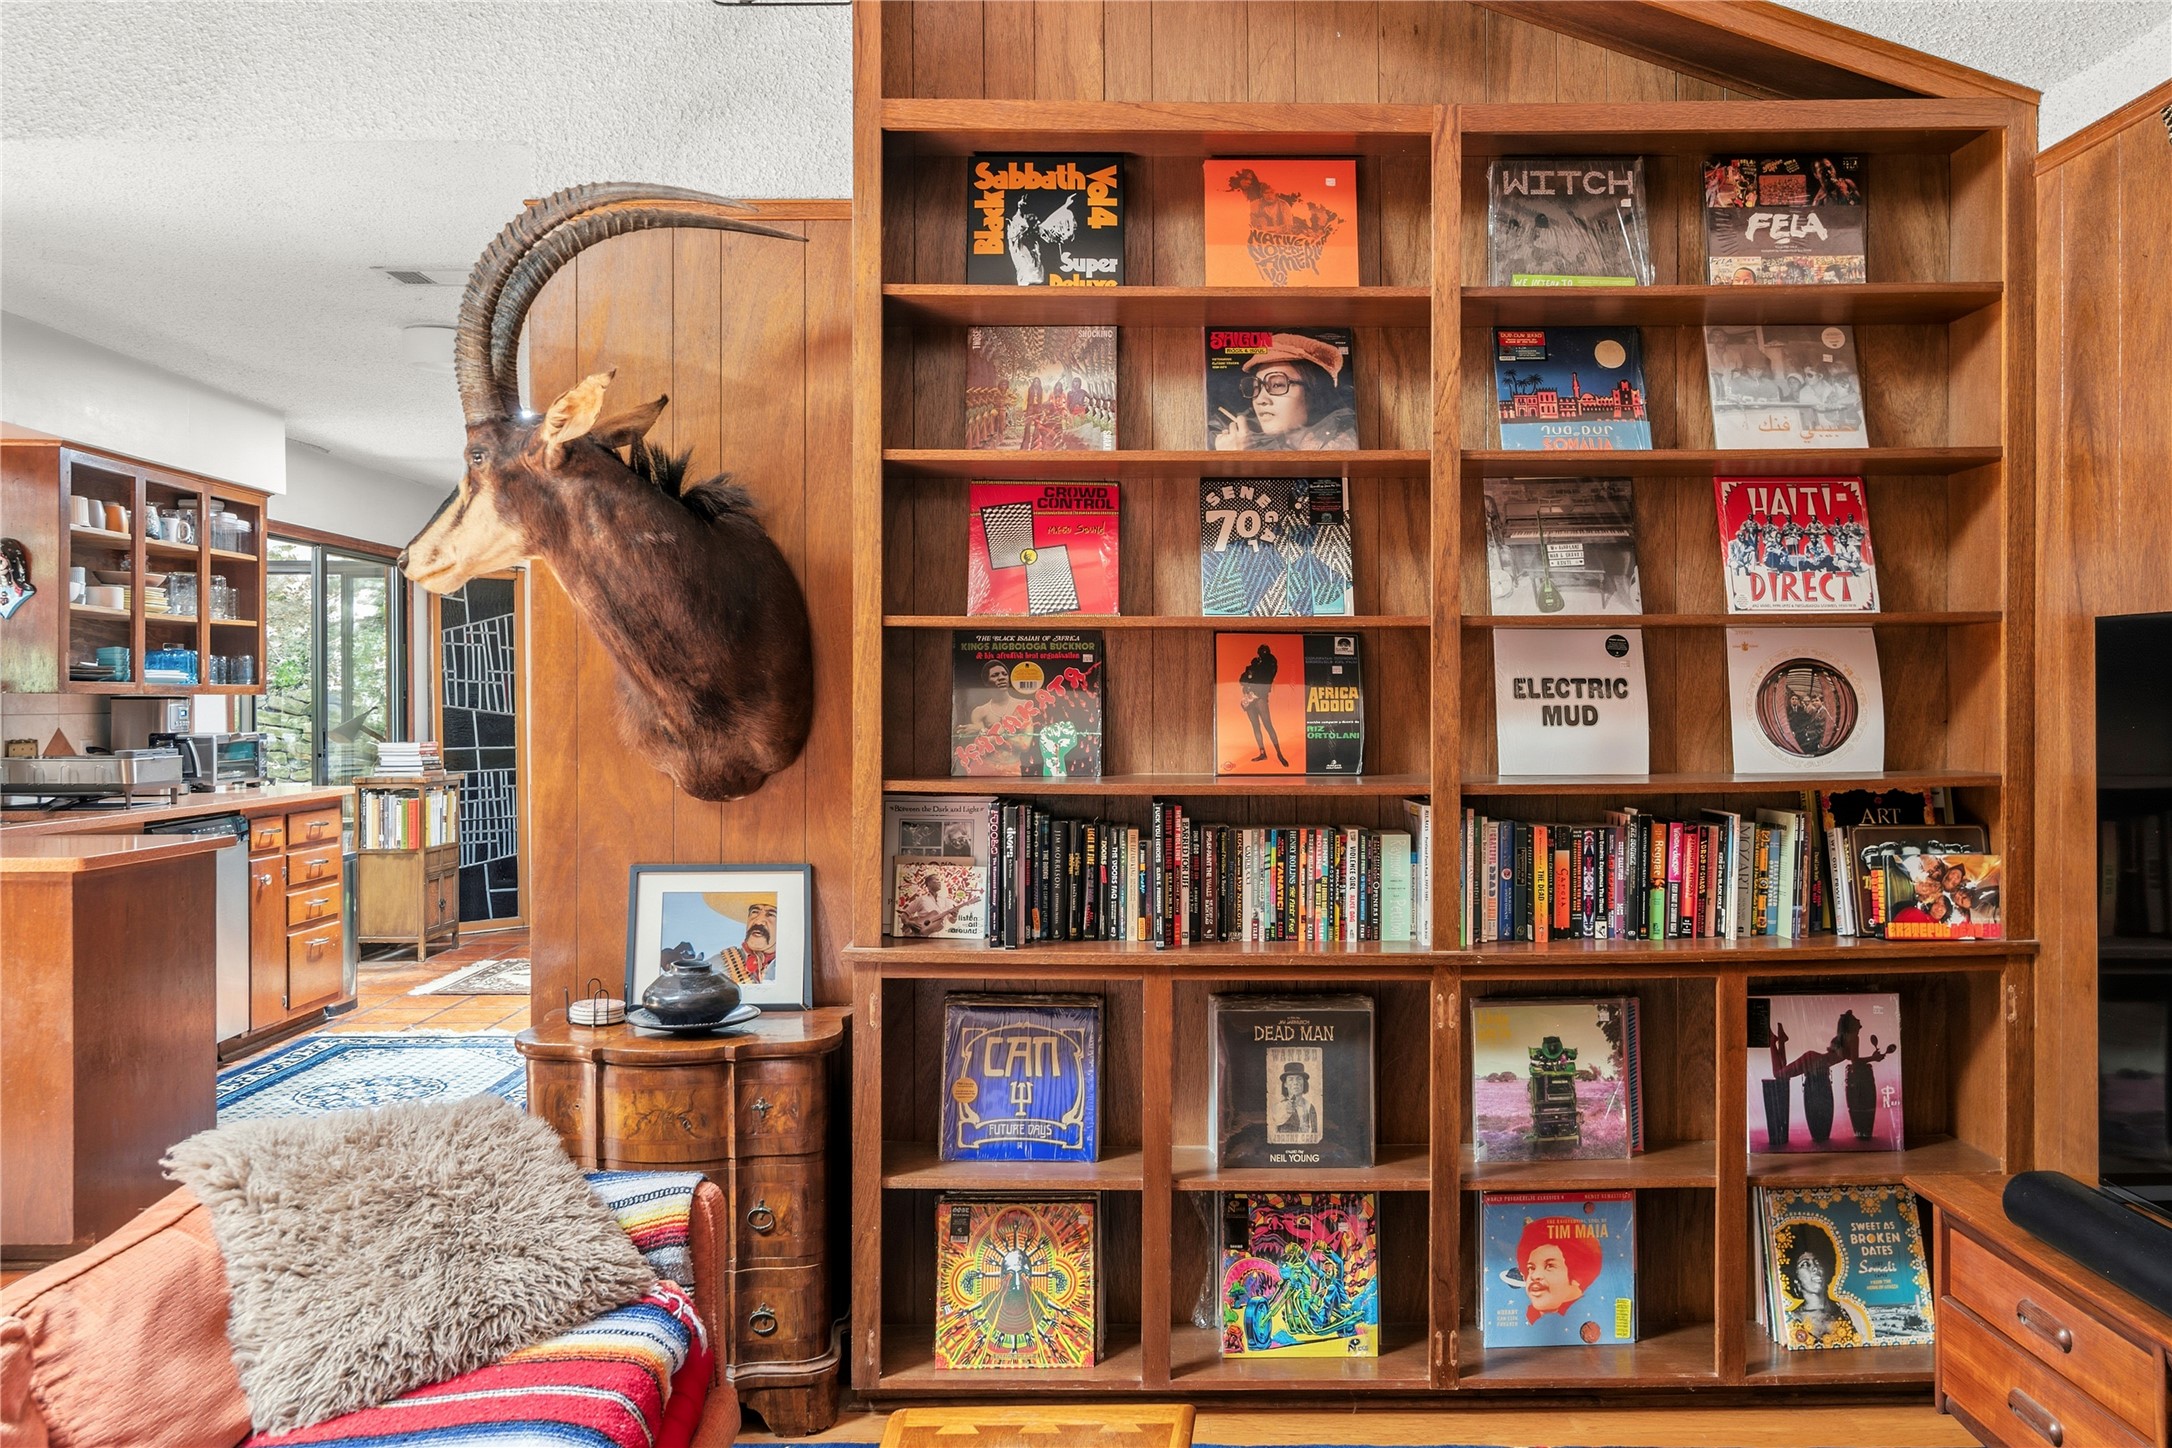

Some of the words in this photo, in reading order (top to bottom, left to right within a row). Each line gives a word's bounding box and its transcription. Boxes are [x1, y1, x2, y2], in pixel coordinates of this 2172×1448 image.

[973, 161, 1086, 190] Sabbath
[1502, 170, 1634, 195] WITCH
[1085, 164, 1118, 207] Vol
[973, 190, 1005, 255] Black
[1087, 207, 1118, 230] 4
[1744, 212, 1828, 245] FELA
[1247, 229, 1305, 247] NATIVE
[1059, 251, 1119, 278] Super
[1210, 331, 1274, 350] SAIGON
[1043, 486, 1108, 498] CROWD
[1037, 498, 1115, 509] CONTROL
[1750, 571, 1854, 602] DIRECT
[961, 642, 990, 651] KINGS
[1050, 642, 1095, 651] BUCKNOR
[1513, 677, 1629, 699] ELECTRIC
[1542, 704, 1599, 727] MUD
[1306, 725, 1325, 733] RIZ
[894, 804, 921, 813] Between
[921, 804, 932, 813] the
[932, 804, 949, 813] Dark
[950, 804, 962, 813] and
[962, 805, 980, 815] Light
[1155, 806, 1163, 824] FUCK
[1861, 808, 1901, 824] ART
[1053, 830, 1062, 843] JIM
[1086, 828, 1095, 844] LIGHT
[1181, 821, 1190, 855] BARRED
[1629, 822, 1637, 838] THE
[1086, 845, 1095, 854] MY
[1205, 830, 1213, 867] SPRAY-PAINT
[1289, 830, 1297, 854] HENRY
[1830, 839, 1837, 852] WE
[1086, 854, 1095, 866] FIRE
[1110, 846, 1118, 859] THE
[1388, 839, 1407, 877] Raymond
[1629, 838, 1637, 866] SOURCE
[1652, 840, 1664, 876] Reggae
[1699, 840, 1708, 864] LORDS
[1738, 826, 1752, 895] MOZART
[1053, 846, 1062, 889] MORRISON
[1110, 859, 1118, 884] DOORS
[1181, 856, 1189, 873] FOR
[1205, 867, 1213, 878] THE
[1289, 854, 1297, 885] ROLLINS
[1181, 873, 1189, 889] LIFE
[1489, 865, 1498, 897] DEAD
[1537, 870, 1545, 883] THE
[1699, 871, 1707, 895] CHAOS
[1110, 885, 1118, 900] FAQ
[1205, 878, 1213, 897] WALLS
[1537, 884, 1545, 902] DEAD
[958, 913, 979, 922] listen
[1390, 899, 1407, 938] Pettibon
[1254, 1025, 1295, 1042] DEAD
[1300, 1025, 1335, 1042] MAN
[983, 1036, 1062, 1078] CAN
[1271, 1049, 1319, 1062] WANTED
[988, 1123, 1025, 1135] FUTURE
[1269, 1154, 1288, 1163] NEIL
[1289, 1153, 1320, 1163] YOUNG
[1547, 1224, 1571, 1240] TIM
[1575, 1223, 1609, 1239] MAIA
[1850, 1221, 1881, 1232] SWEET
[1882, 1221, 1896, 1231] AS
[1850, 1232, 1901, 1245] BROKEN
[1861, 1245, 1894, 1257] DATES
[1857, 1259, 1898, 1275] Somali
